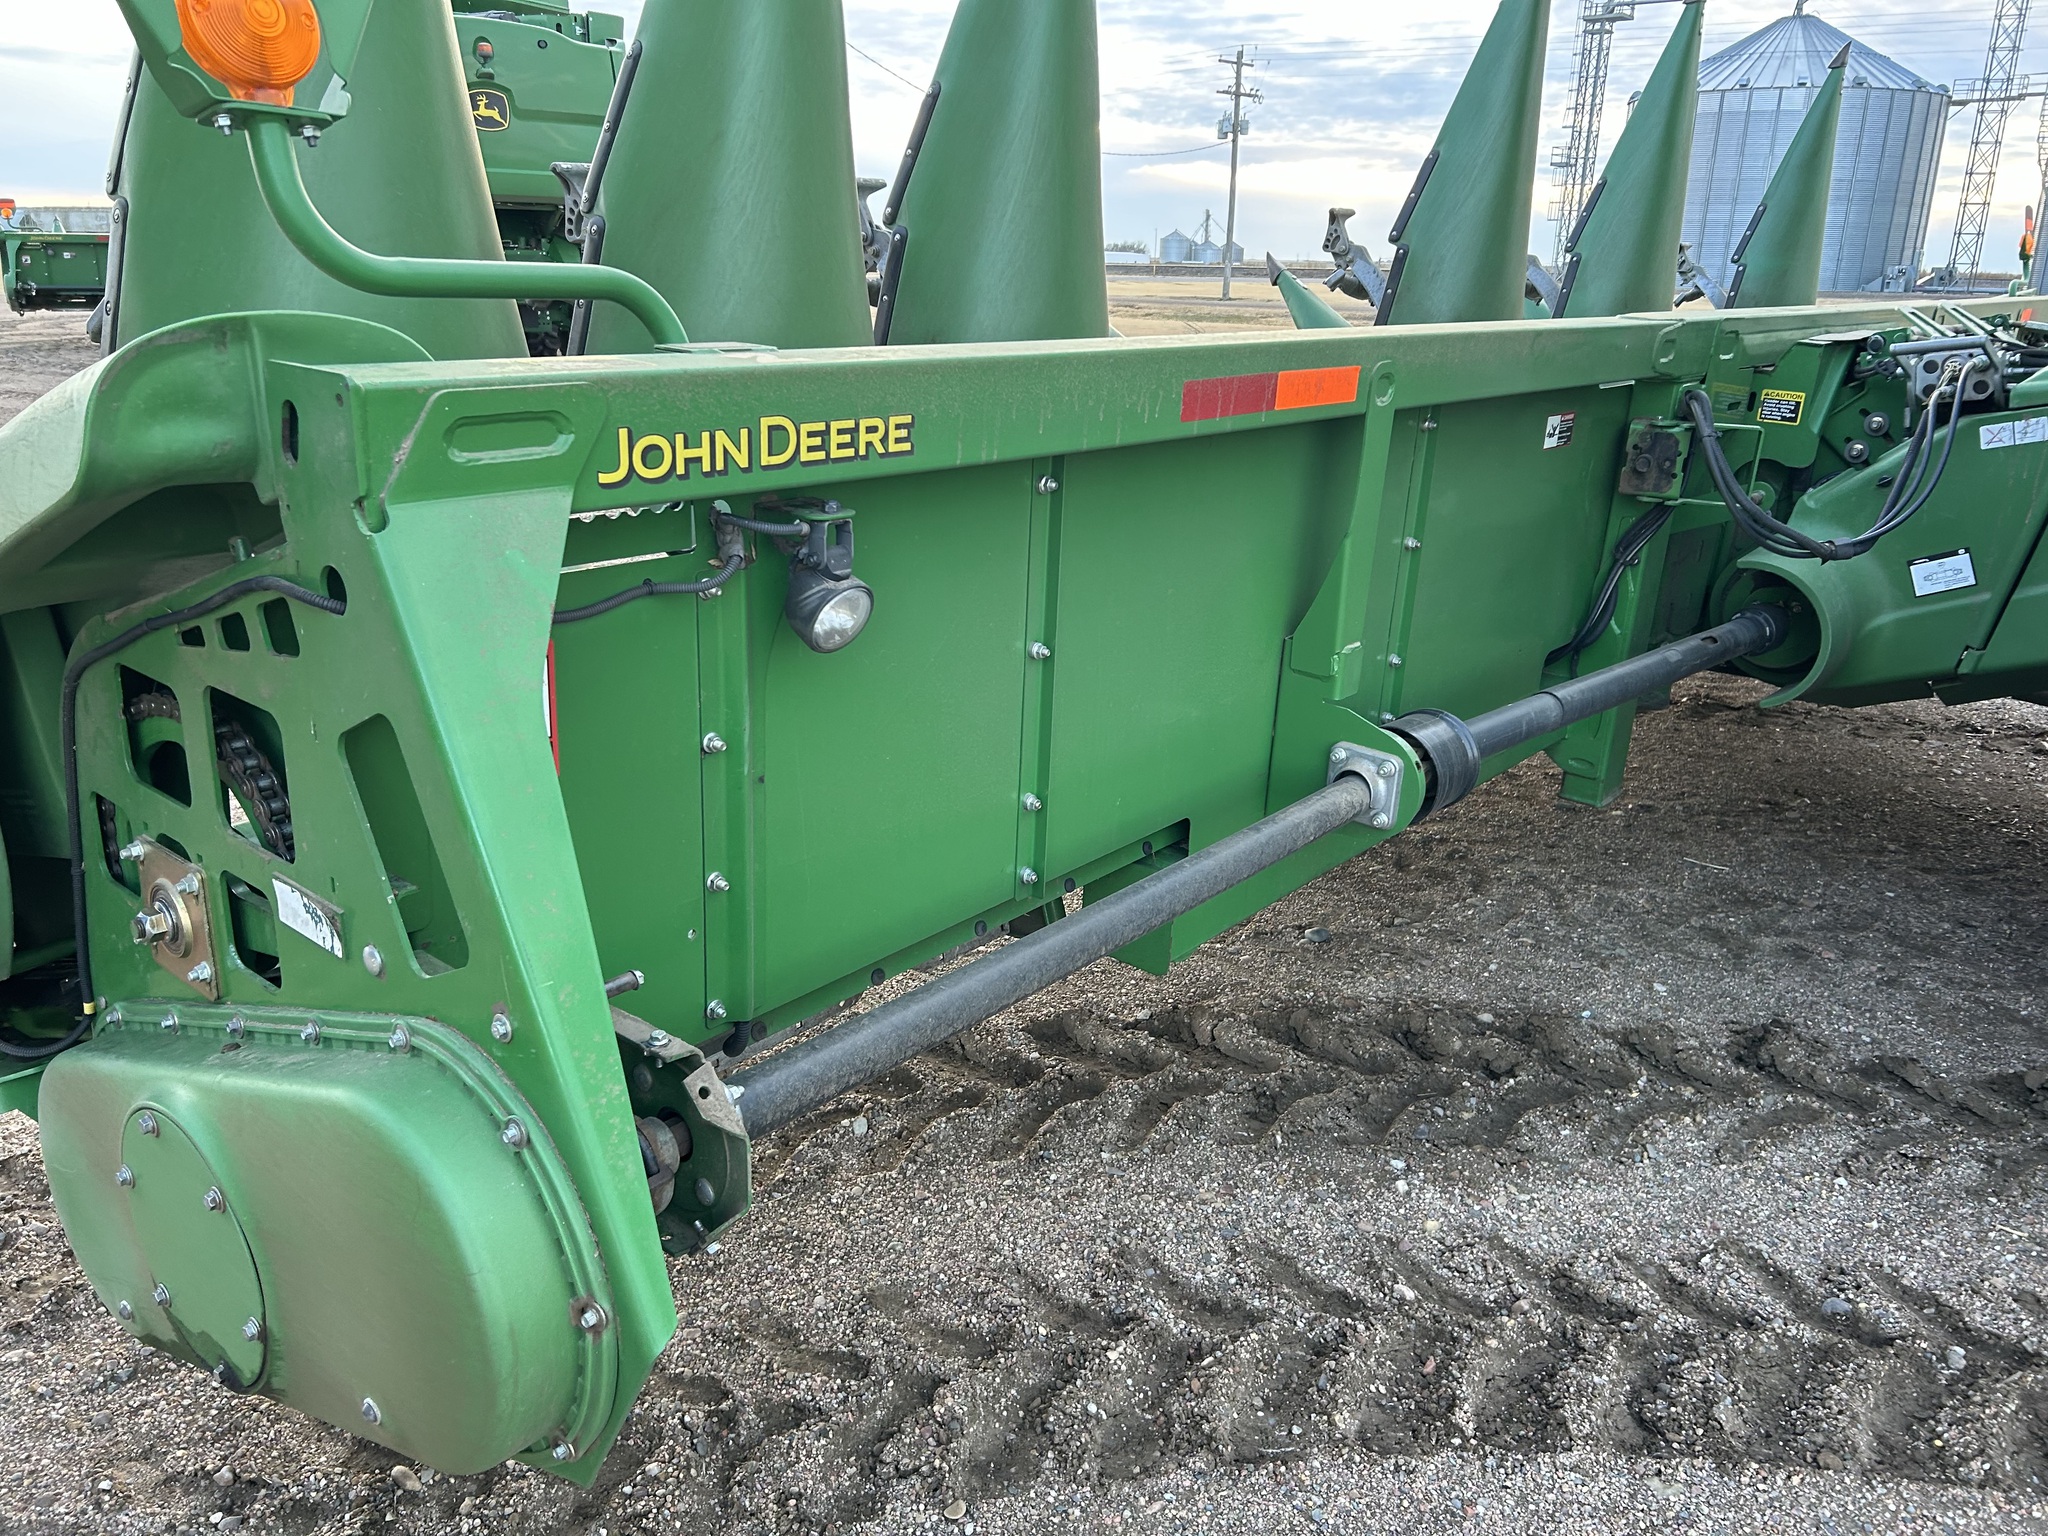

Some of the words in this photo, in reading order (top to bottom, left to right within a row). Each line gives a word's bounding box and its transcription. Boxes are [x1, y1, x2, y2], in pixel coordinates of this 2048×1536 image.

[1770, 392, 1803, 400] CAUTION
[597, 426, 753, 489] JOHN
[758, 413, 915, 470] DEERE
